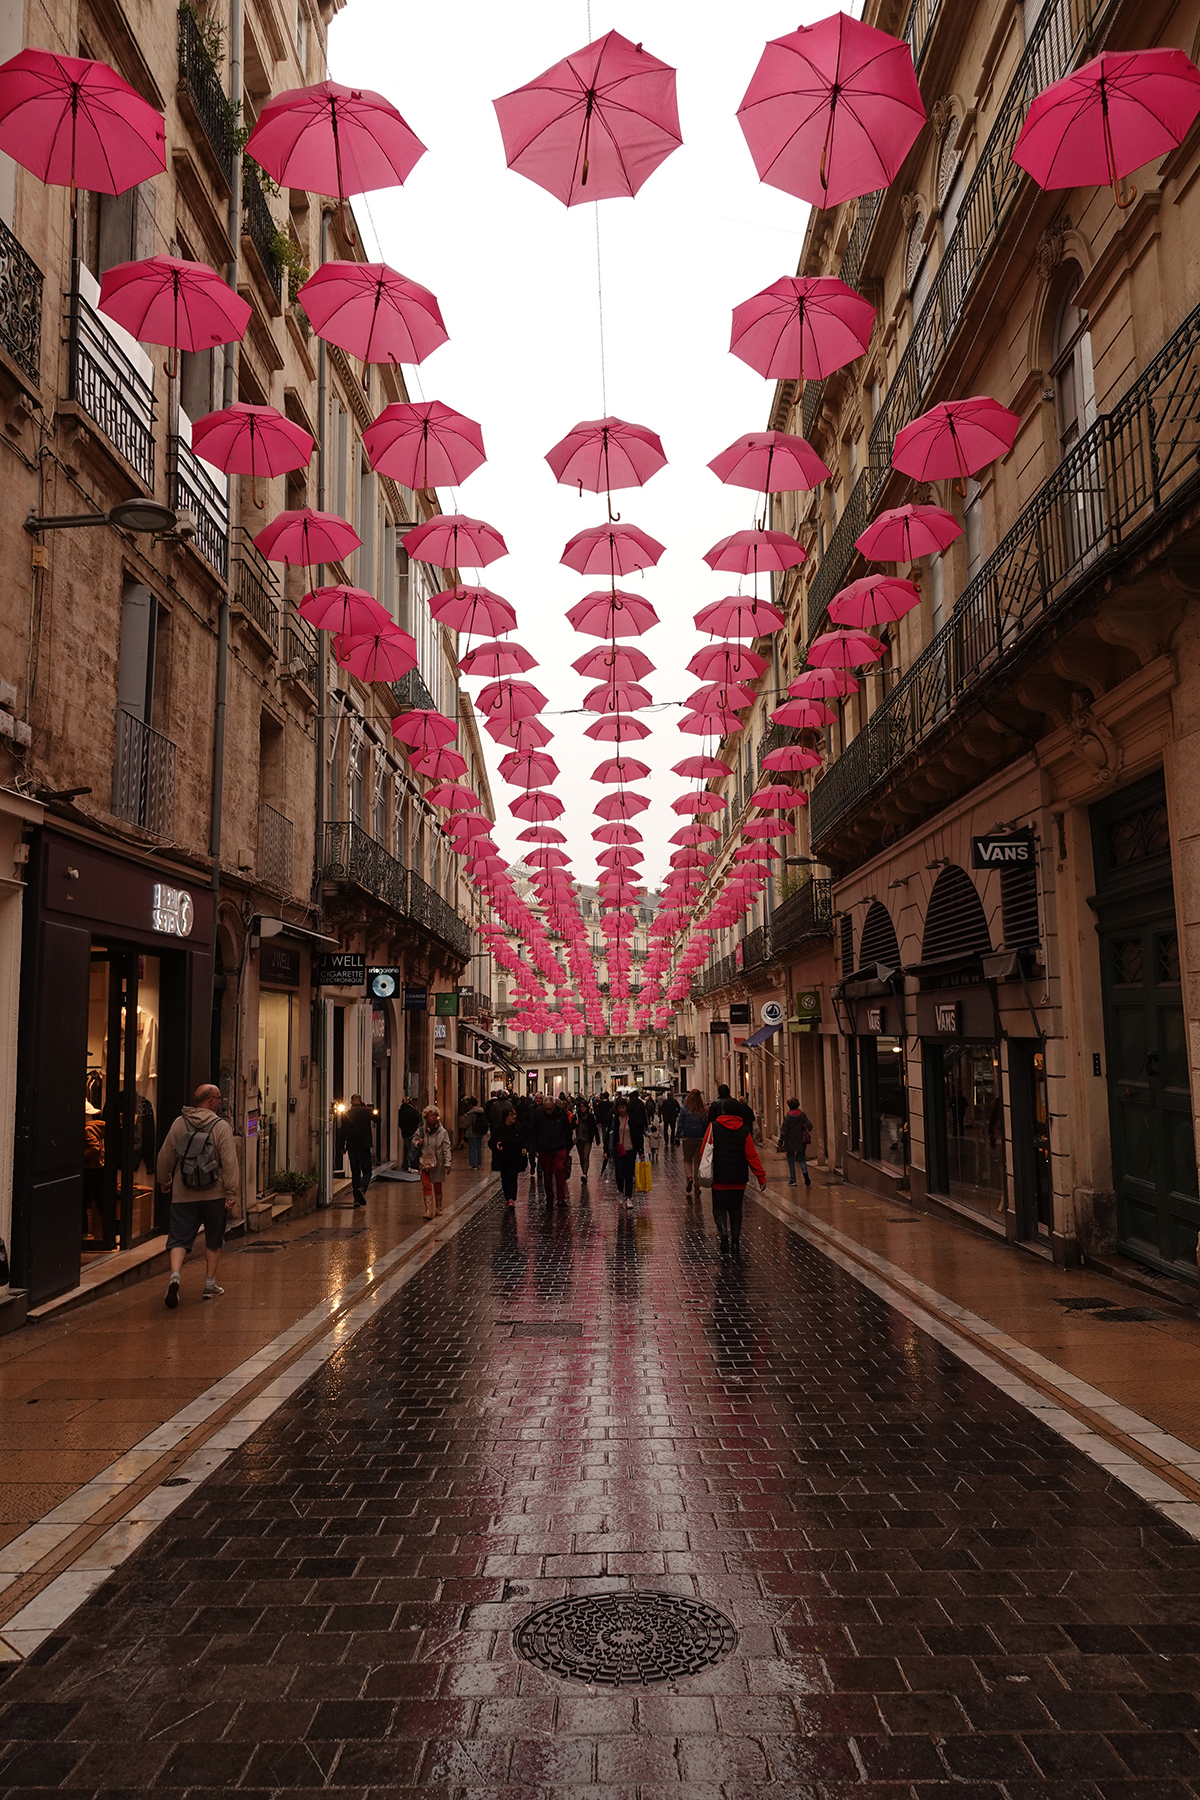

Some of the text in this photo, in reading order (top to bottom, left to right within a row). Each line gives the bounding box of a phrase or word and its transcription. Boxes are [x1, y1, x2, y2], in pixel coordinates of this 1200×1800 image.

[977, 842, 1028, 860] VANS
[320, 955, 363, 967] J WELL
[320, 970, 363, 978] CIGARETTE
[935, 1004, 956, 1031] VANS
